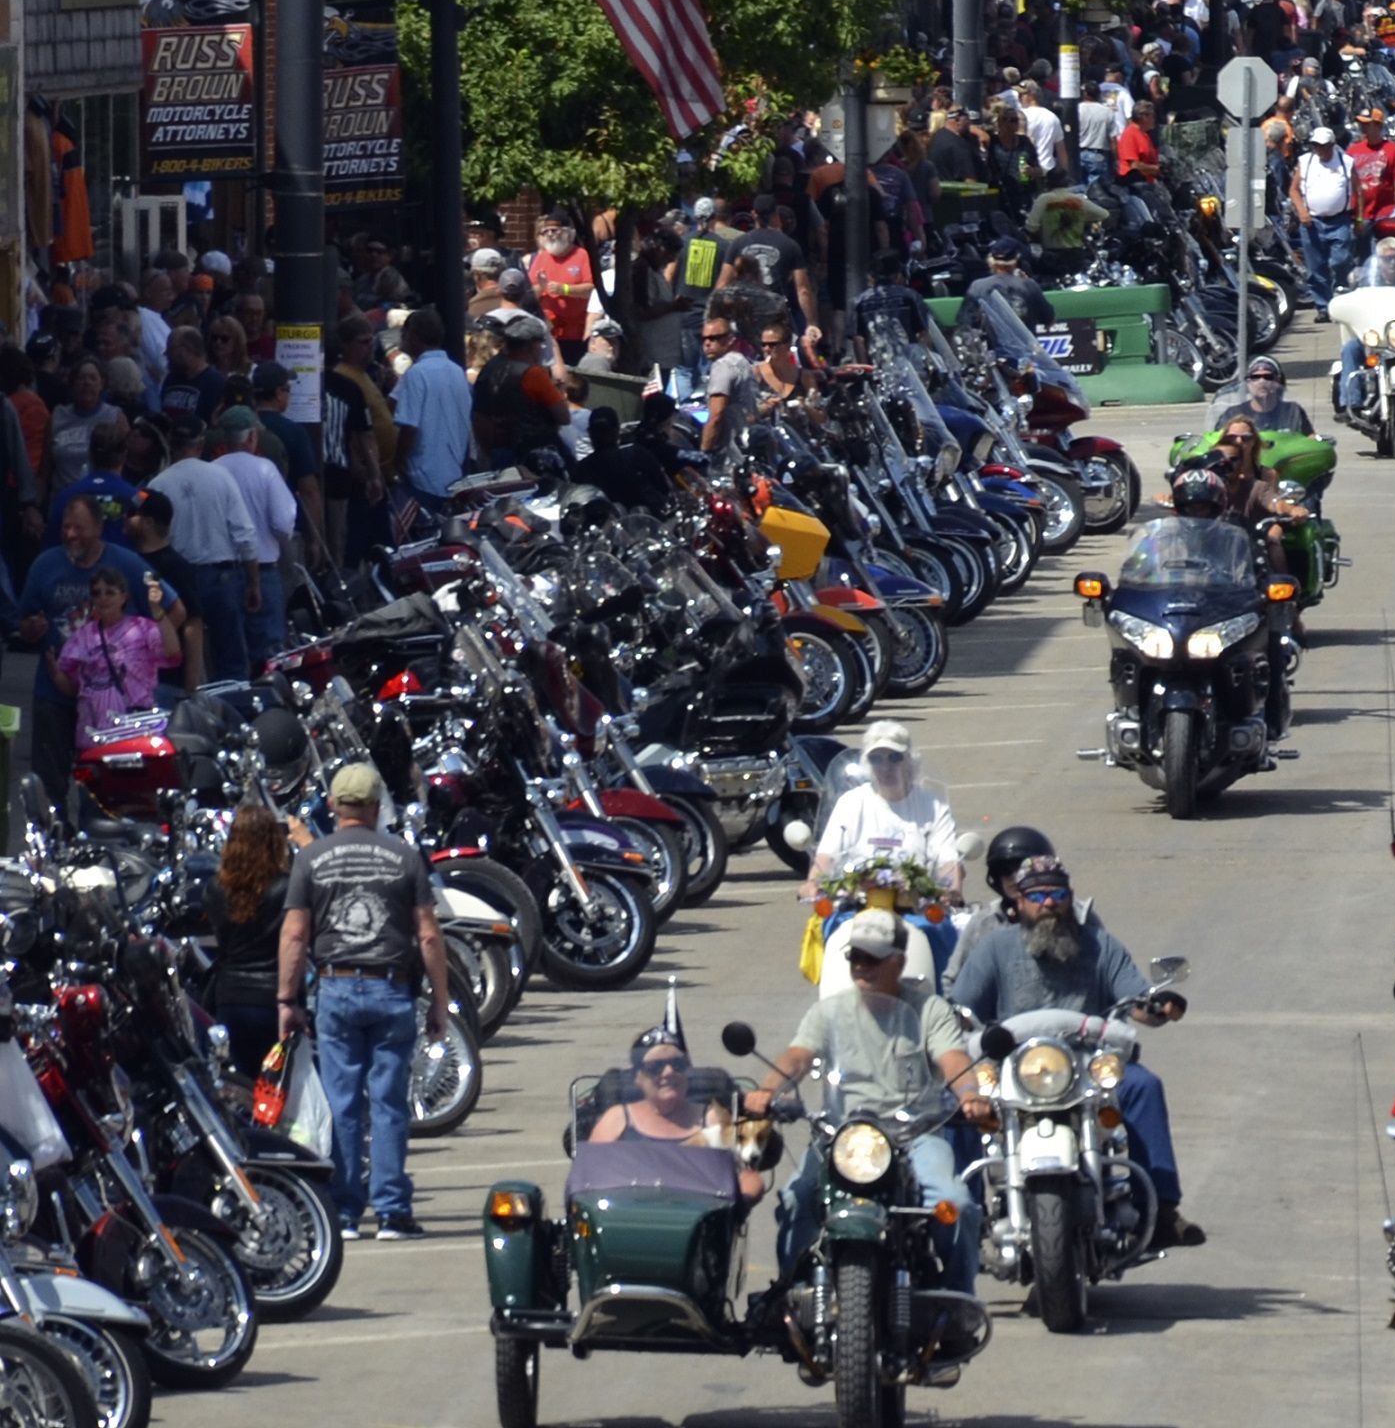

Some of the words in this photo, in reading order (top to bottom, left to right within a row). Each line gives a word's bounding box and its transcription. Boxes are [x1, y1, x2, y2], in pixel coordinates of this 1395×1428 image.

[154, 33, 247, 70] RUSS
[152, 74, 244, 102] BROWN
[147, 104, 252, 122] MOTORCYCLE
[152, 123, 249, 142] ATTORNEYS
[325, 111, 394, 137] ROWN
[324, 139, 402, 156] OTORCYCLE
[324, 157, 399, 177] TTORNEYS
